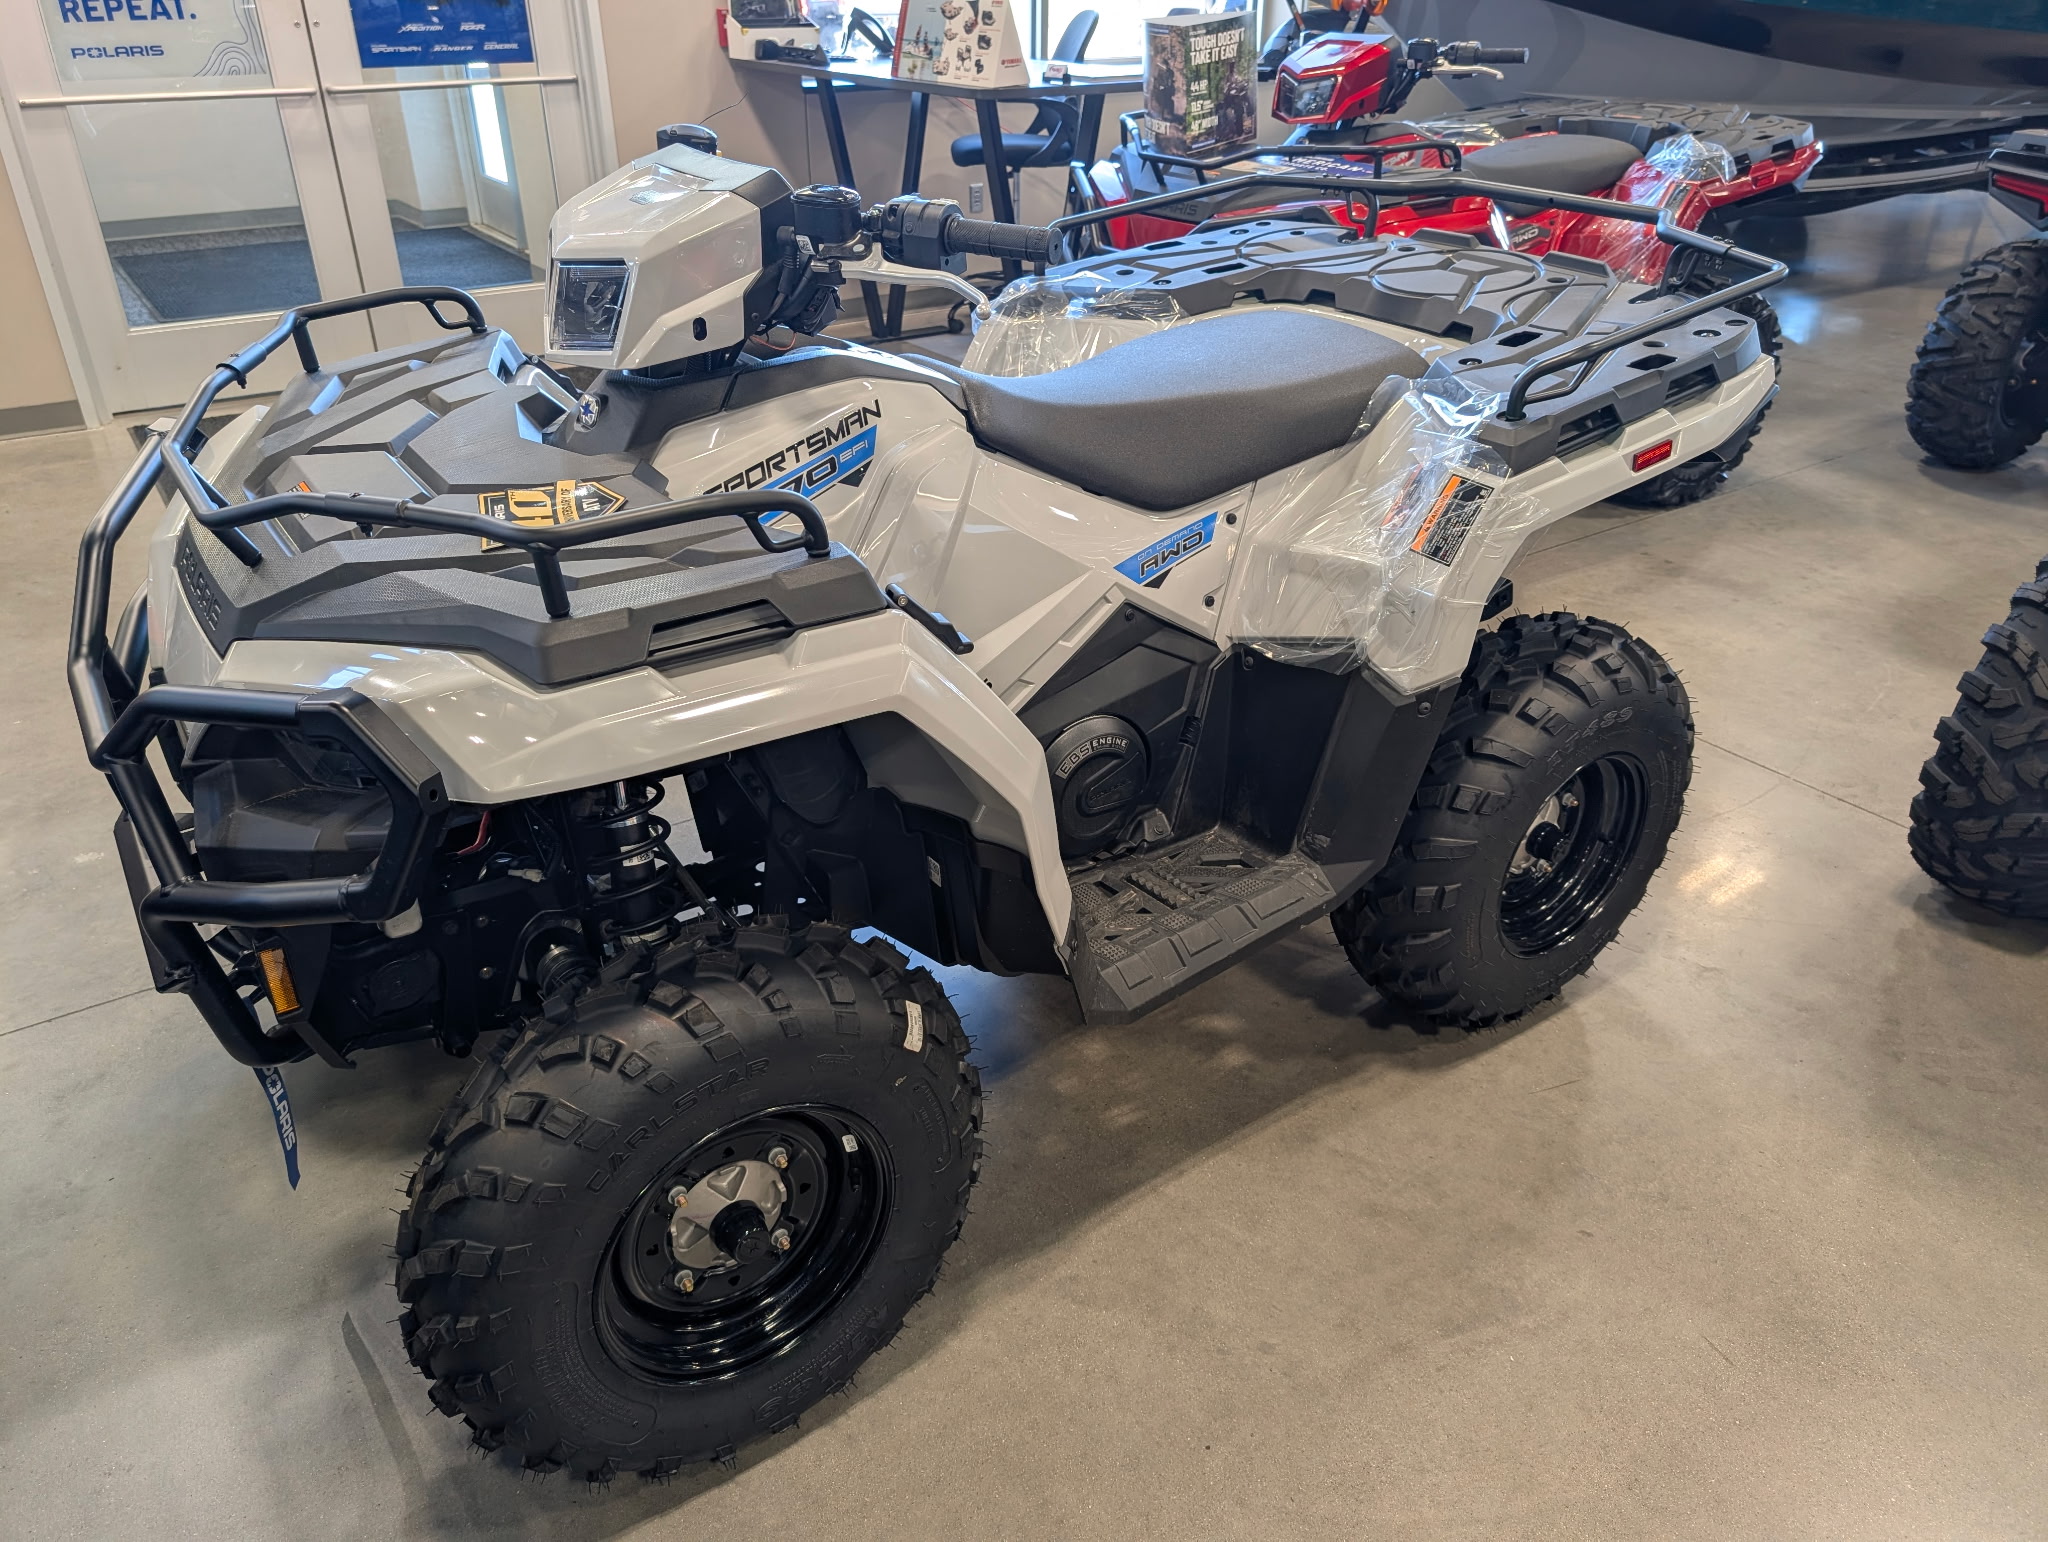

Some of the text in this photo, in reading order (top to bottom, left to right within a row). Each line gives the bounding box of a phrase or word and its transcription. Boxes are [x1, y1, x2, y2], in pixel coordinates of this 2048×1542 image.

[58, 0, 197, 23] REPEAT.
[1189, 28, 1245, 51] TOUGH DOESN'T
[71, 45, 165, 59] POLARIS
[1190, 44, 1238, 65] TAKE IT EASY
[839, 440, 869, 463] EFI
[582, 498, 601, 512] ATV
[1140, 530, 1204, 578] AWD
[181, 543, 222, 631] POLARIS
[1059, 736, 1128, 775] EBS ENGINE
[585, 1057, 770, 1193] CARLSTAR
